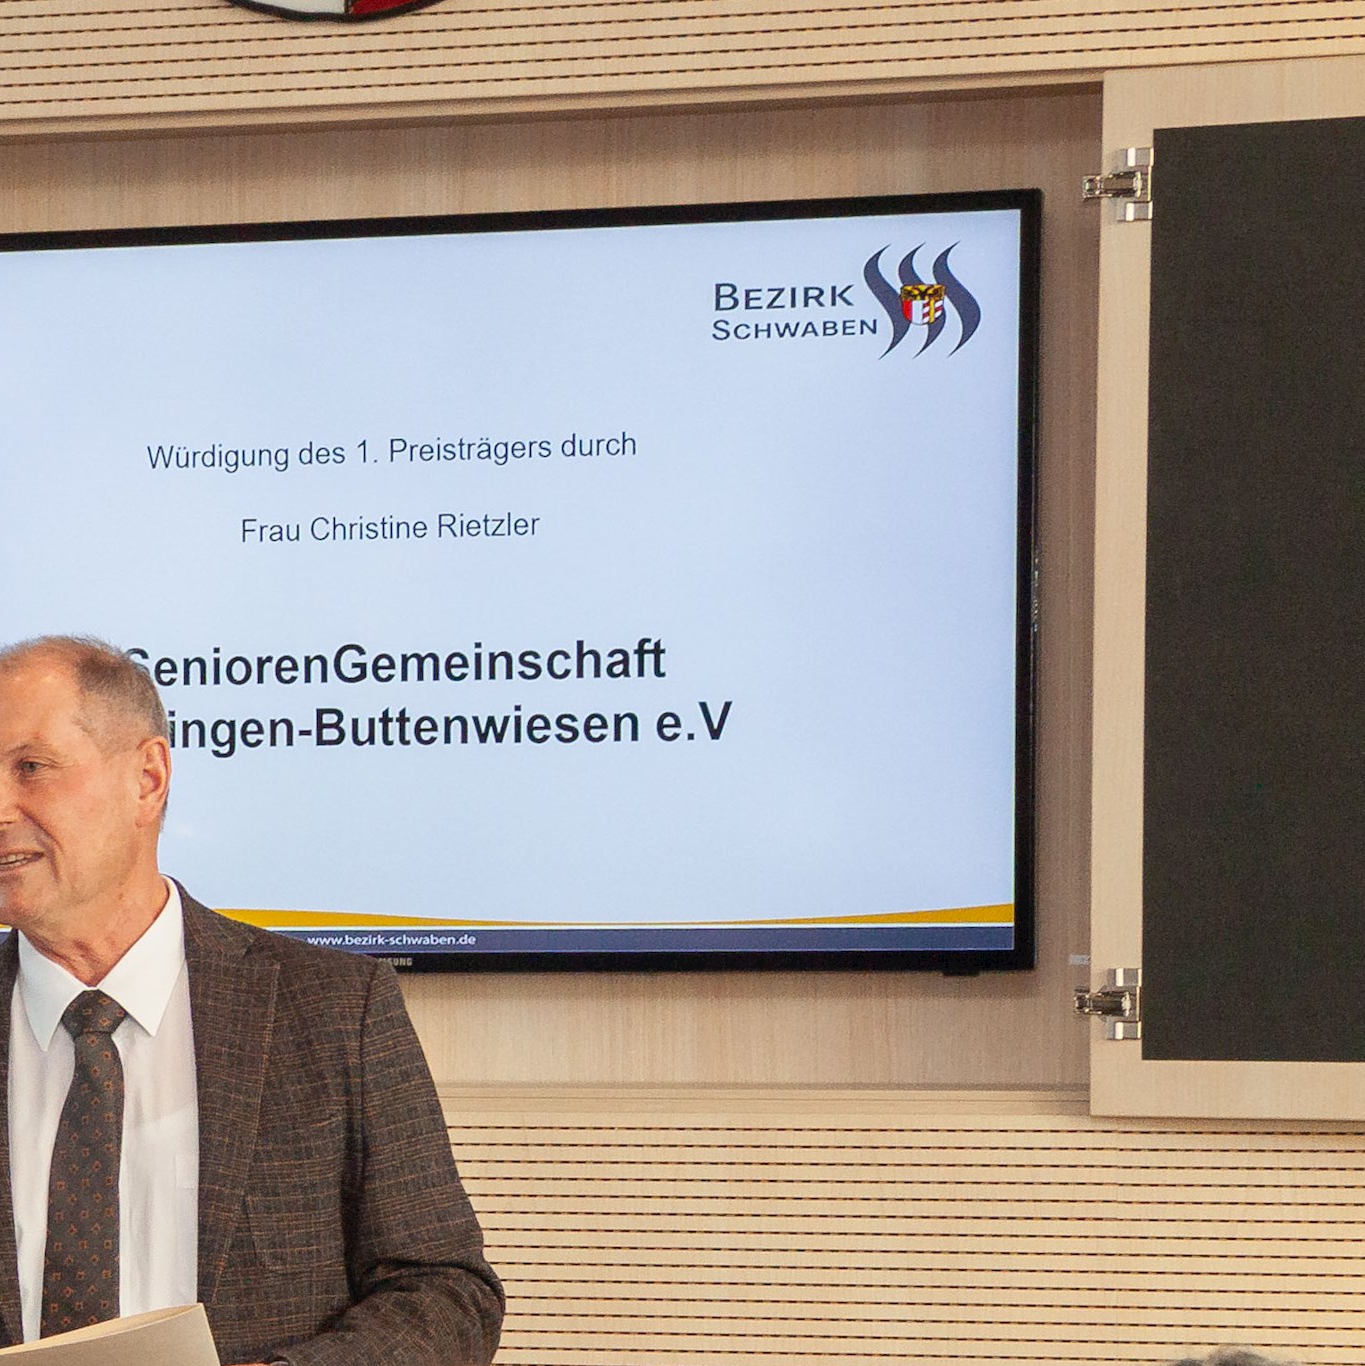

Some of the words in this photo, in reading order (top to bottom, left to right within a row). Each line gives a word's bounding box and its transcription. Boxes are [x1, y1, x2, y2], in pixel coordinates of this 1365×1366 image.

[714, 282, 855, 312] BEZIRK
[712, 318, 878, 341] SCHWABEN
[146, 443, 290, 474] Würdigung
[298, 441, 346, 465] des
[356, 439, 378, 464] 1.
[389, 436, 552, 467] Preisträgers
[561, 431, 637, 458] durch
[241, 518, 300, 543] Frau
[310, 514, 428, 541] Christine
[437, 511, 541, 538] Rietzler
[168, 704, 639, 759] ingen-Buttenwiesen
[655, 701, 734, 742] e.V
[307, 933, 477, 946] www.bezirk-schwaben.de
